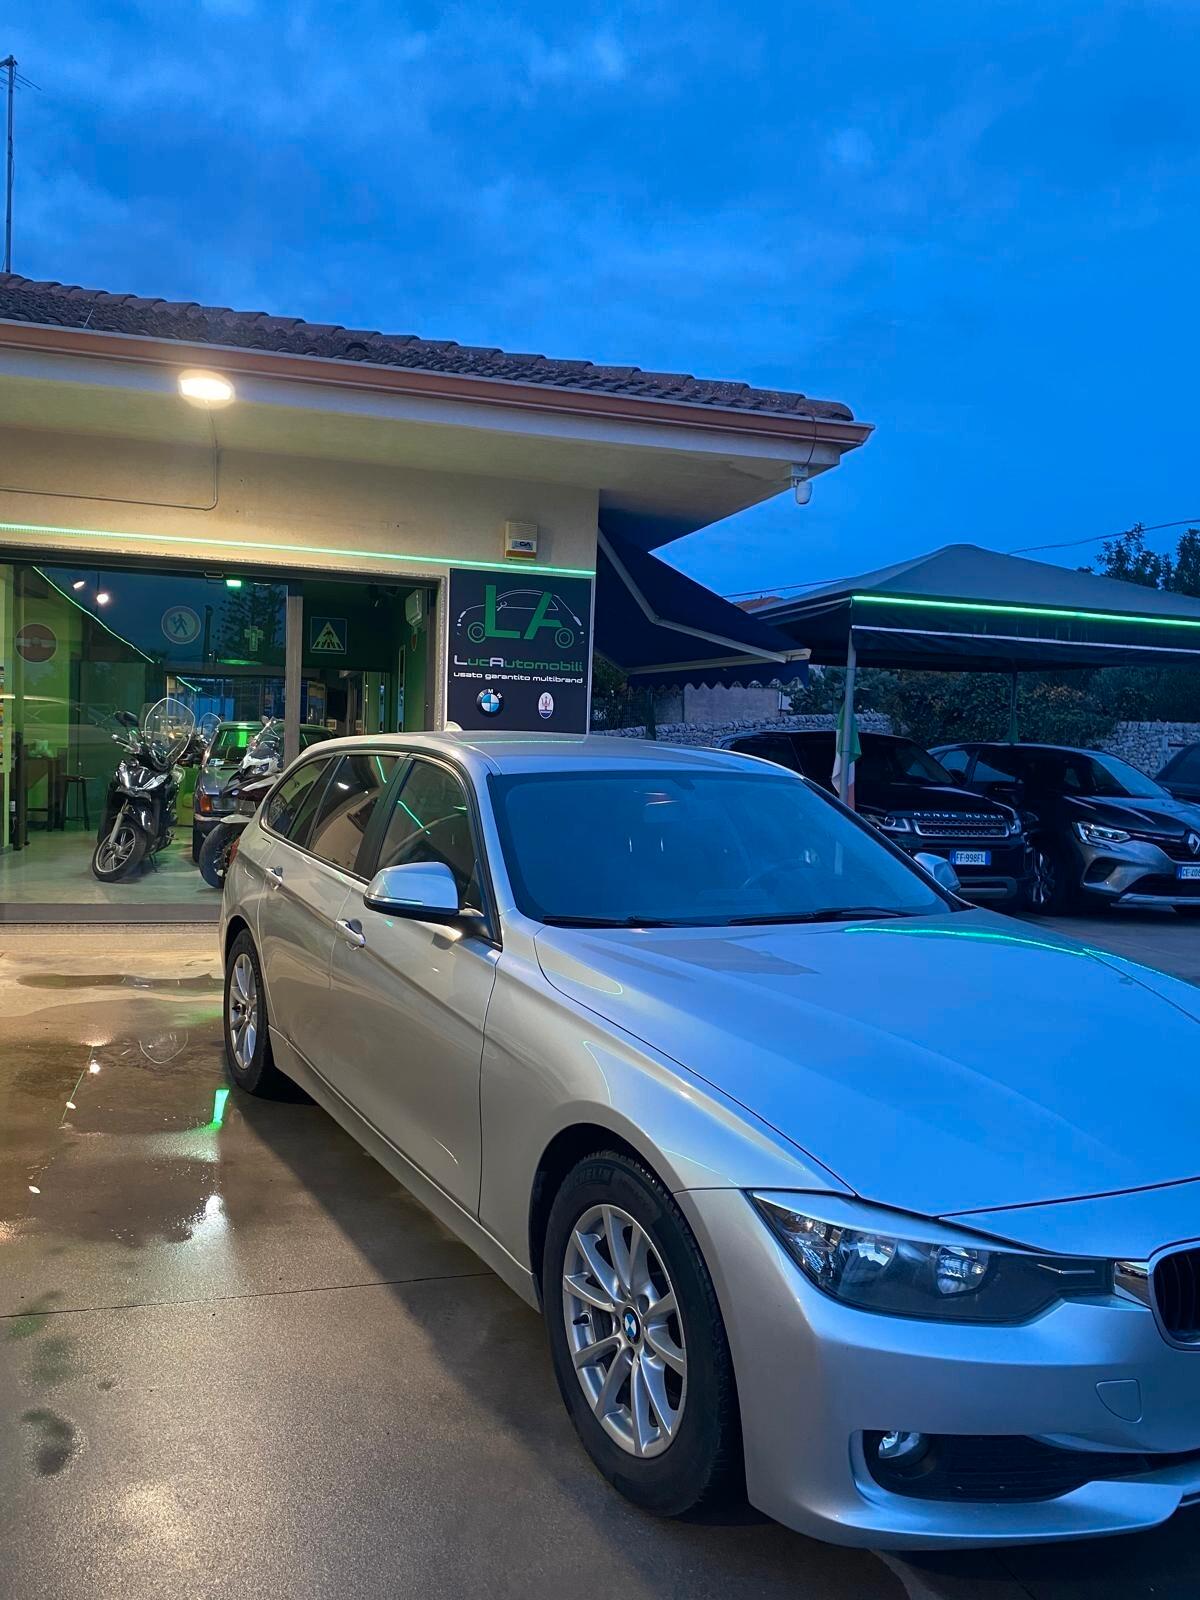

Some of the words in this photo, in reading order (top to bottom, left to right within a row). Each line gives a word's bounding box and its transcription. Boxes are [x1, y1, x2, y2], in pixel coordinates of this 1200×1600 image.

[485, 585, 563, 640] LA
[453, 654, 583, 672] LucAutomobili
[453, 671, 483, 679] usato
[484, 672, 531, 681] garantito
[532, 675, 583, 684] multibrand
